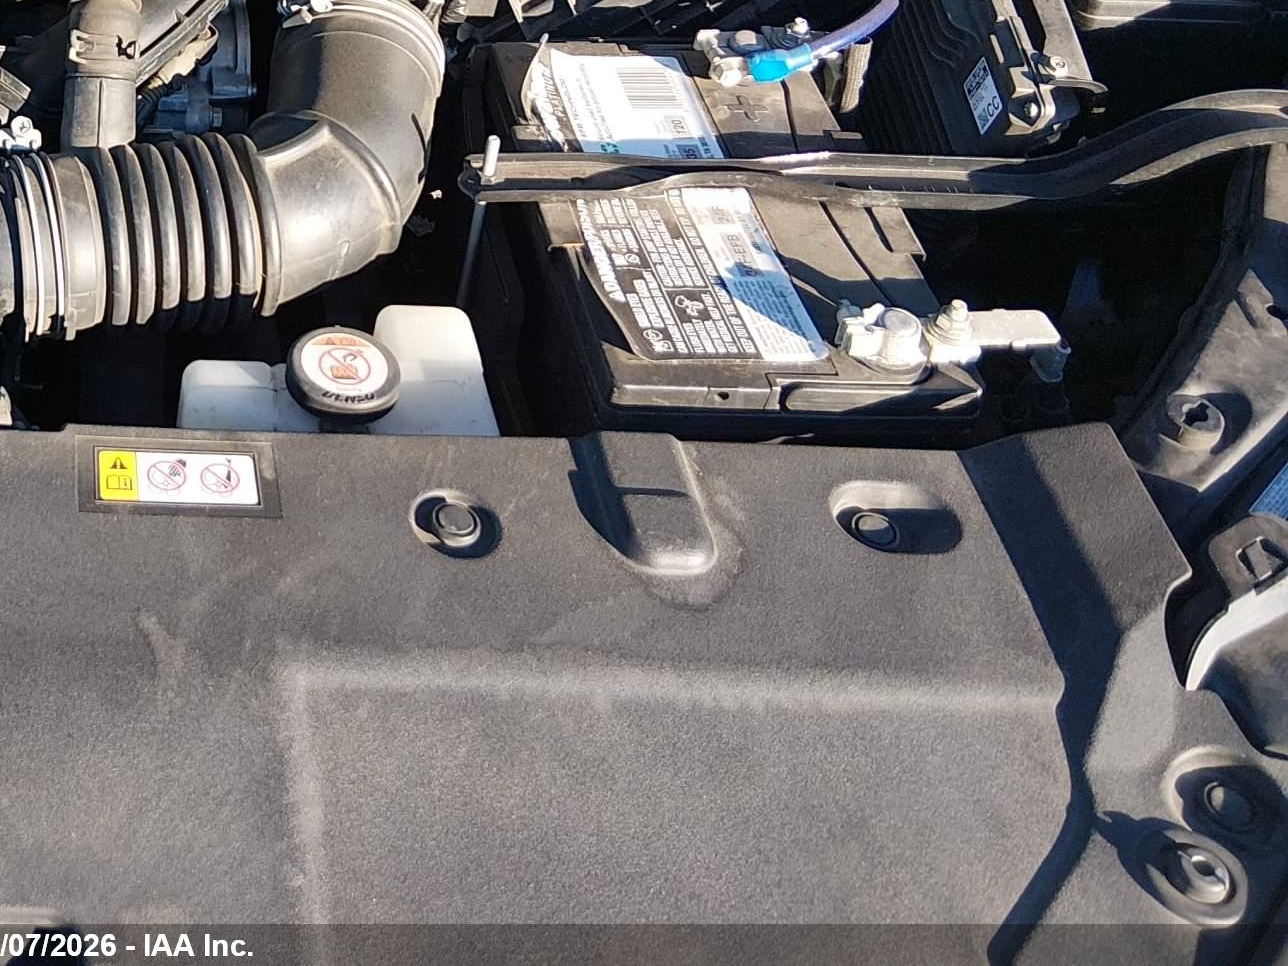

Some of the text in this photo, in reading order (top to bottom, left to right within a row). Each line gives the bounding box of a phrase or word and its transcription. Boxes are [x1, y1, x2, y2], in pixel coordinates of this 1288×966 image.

[987, 95, 1000, 117] CC
[672, 119, 687, 134] 120
[707, 306, 722, 319] HELP
[722, 303, 737, 314] THE
[728, 316, 742, 324] OF
[682, 322, 697, 335] EYES
[713, 319, 733, 341] MEDICAL
[732, 325, 748, 336] OUT
[724, 342, 738, 353] GET
[738, 338, 756, 352] KEEP
